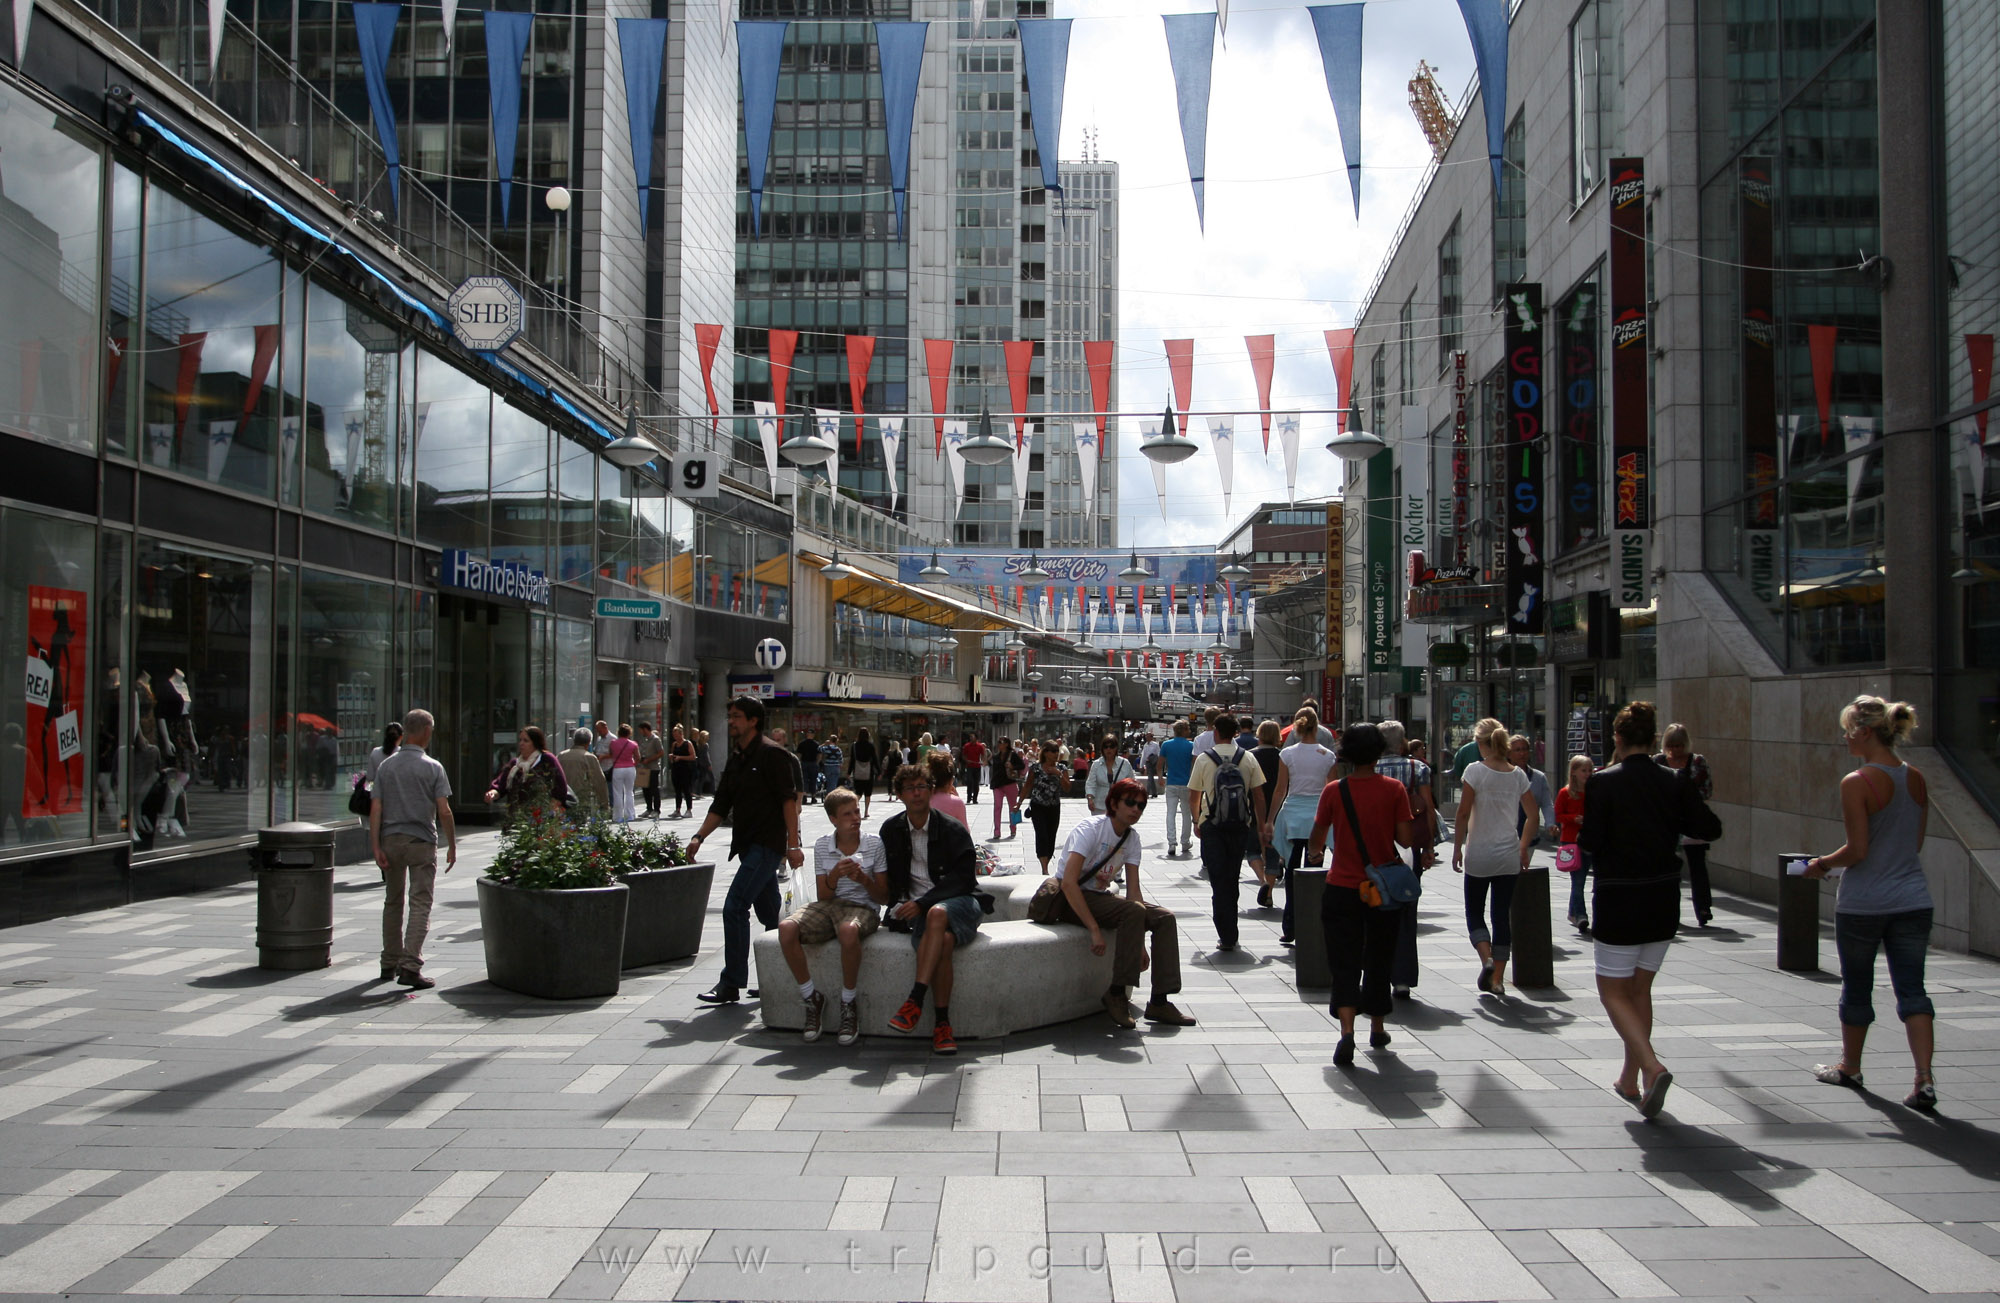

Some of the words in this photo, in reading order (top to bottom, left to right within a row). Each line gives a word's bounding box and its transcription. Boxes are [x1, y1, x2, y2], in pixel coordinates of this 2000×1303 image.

[1611, 180, 1644, 201] Pizza
[1617, 189, 1641, 204] Hut
[459, 302, 509, 324] SHB
[1612, 319, 1646, 340] Pizza
[1619, 328, 1644, 343] Hut
[1510, 345, 1541, 514] GODIS
[683, 458, 707, 489] g
[1404, 494, 1425, 545] Rocher
[1069, 558, 1107, 581] City
[1373, 561, 1385, 592] SHOP
[1434, 567, 1455, 580] Pizza
[1454, 566, 1471, 578] Hut
[1621, 533, 1643, 604] SANDYS
[603, 601, 654, 615] Bankomat
[1329, 569, 1341, 646] BELLMAN
[1373, 599, 1385, 647] Apoteket
[768, 645, 782, 666] T
[26, 673, 49, 697] REA
[59, 726, 78, 750] REA
